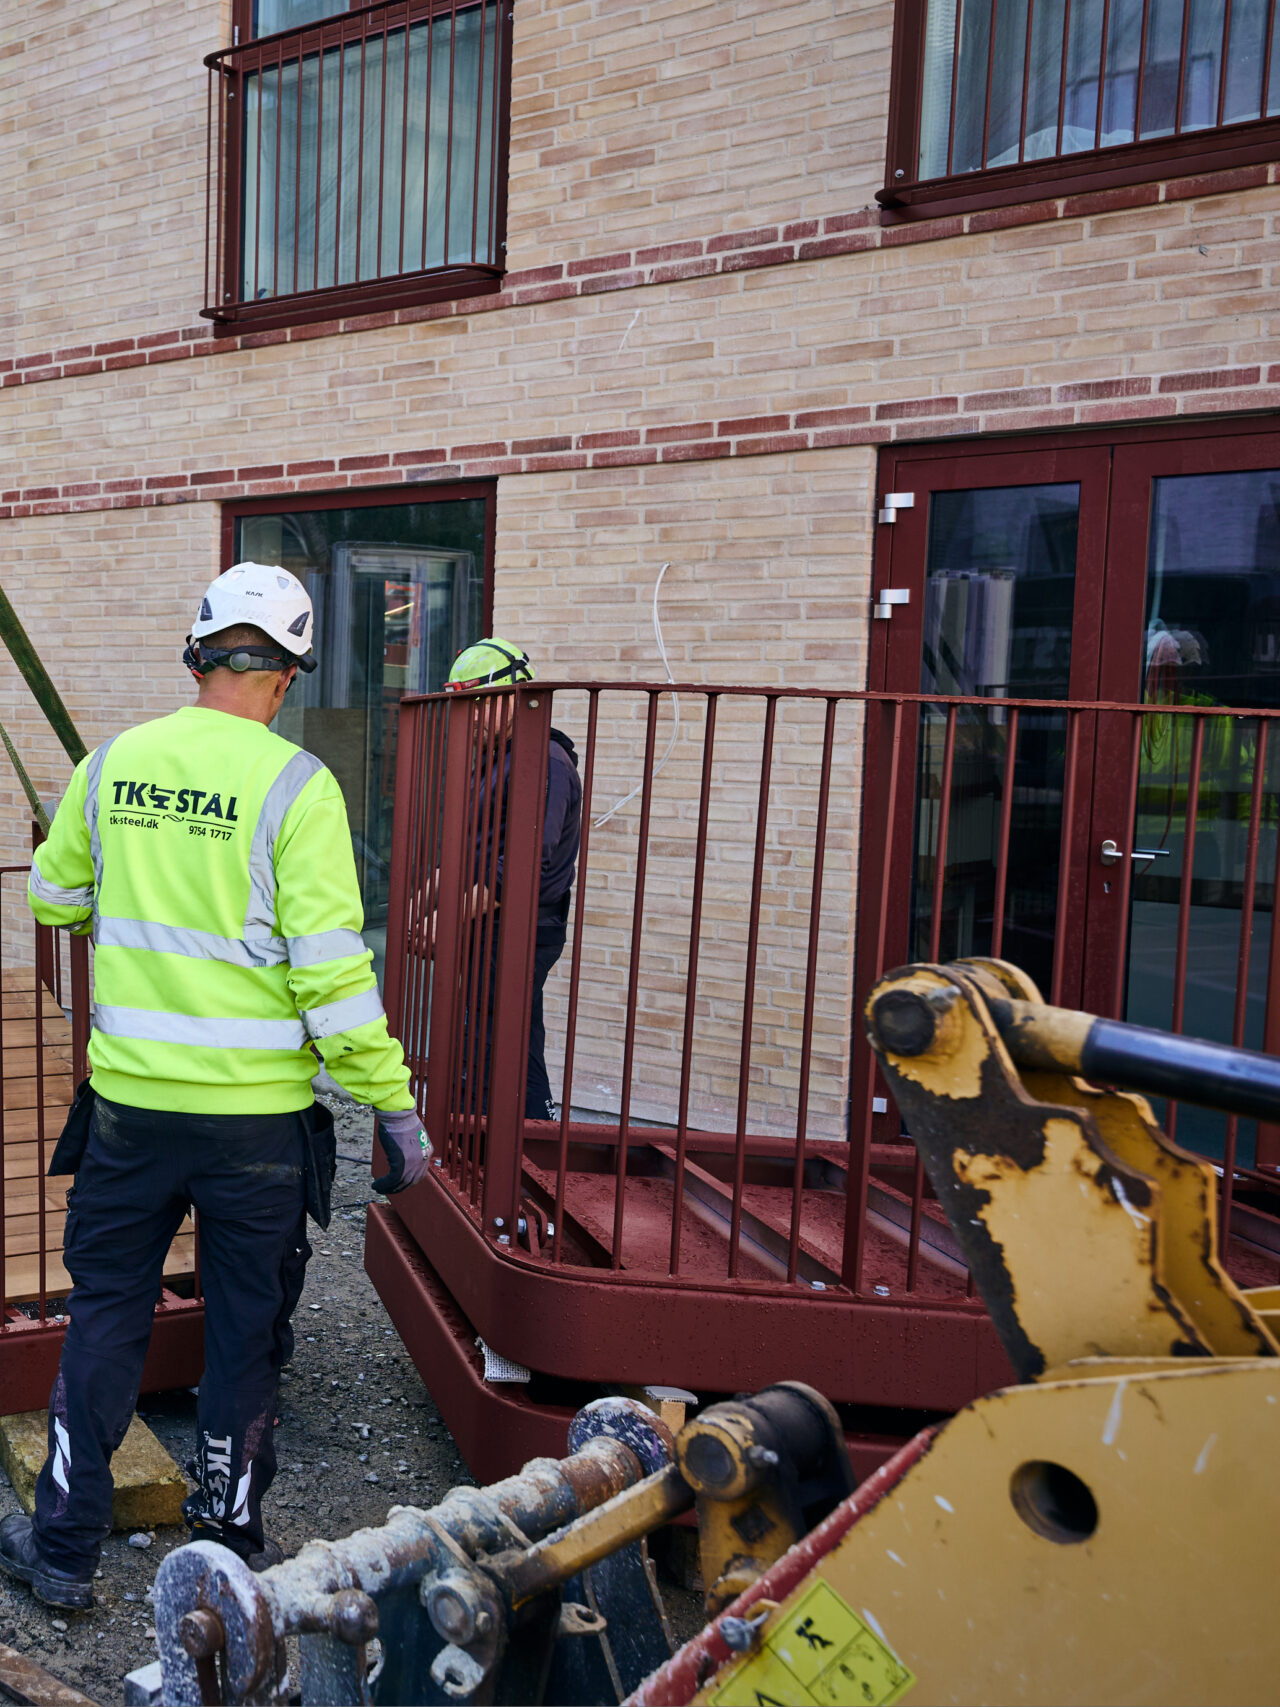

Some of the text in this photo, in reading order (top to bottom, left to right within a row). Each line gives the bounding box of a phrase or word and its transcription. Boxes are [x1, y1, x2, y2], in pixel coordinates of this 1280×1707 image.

[112, 780, 238, 822] TK STÅL
[110, 814, 159, 829] tk-steel.dk
[189, 826, 232, 841] 9754 1717
[207, 1435, 232, 1478] TK
